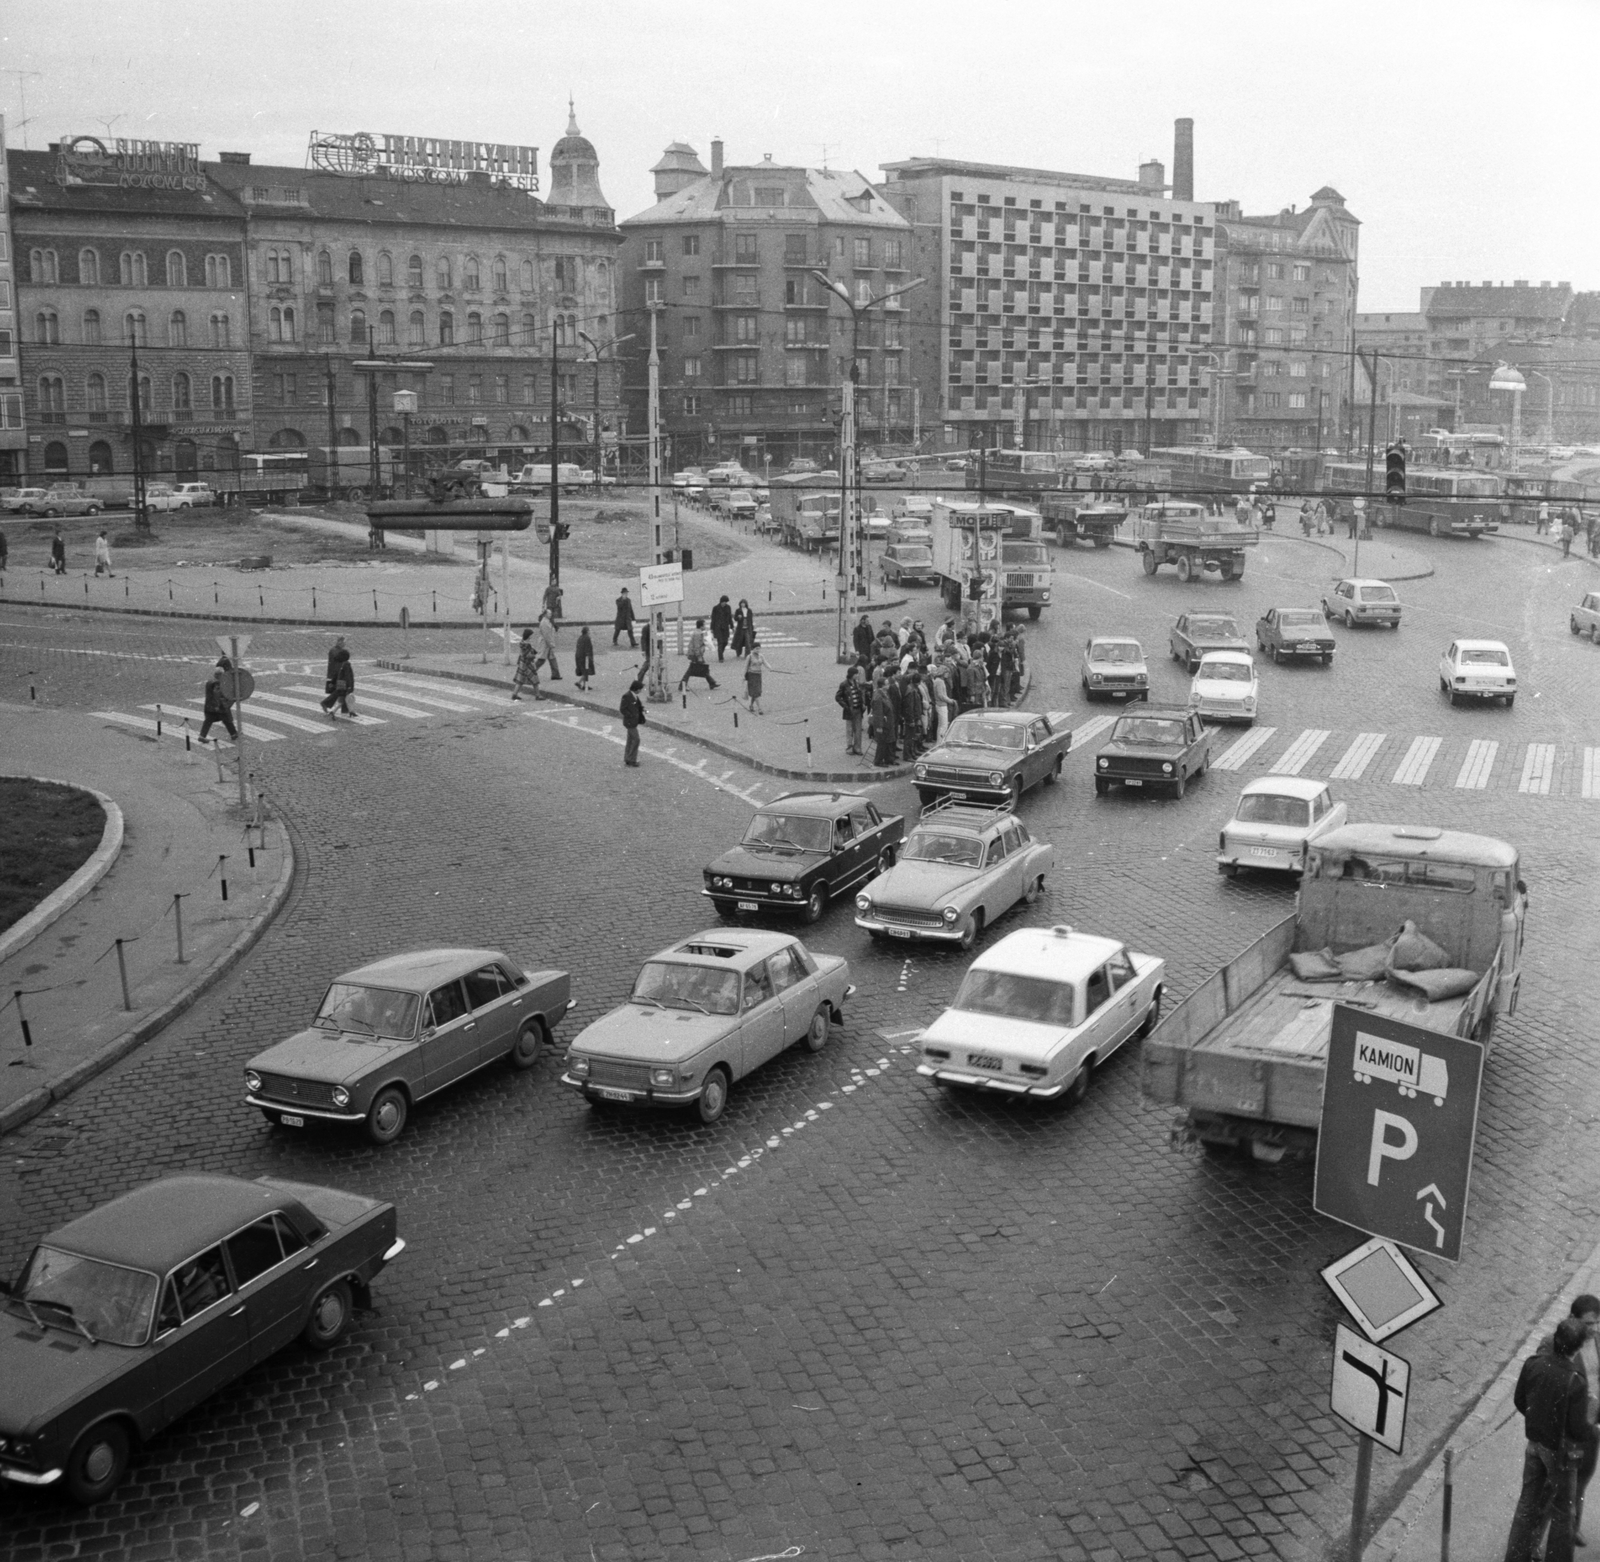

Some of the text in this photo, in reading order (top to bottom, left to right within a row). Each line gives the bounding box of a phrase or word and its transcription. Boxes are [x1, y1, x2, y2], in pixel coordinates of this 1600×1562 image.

[387, 165, 469, 186] MOSCOW
[956, 516, 990, 525] MOZI
[1359, 1044, 1414, 1076] KAMION
[1367, 1108, 1419, 1187] P
